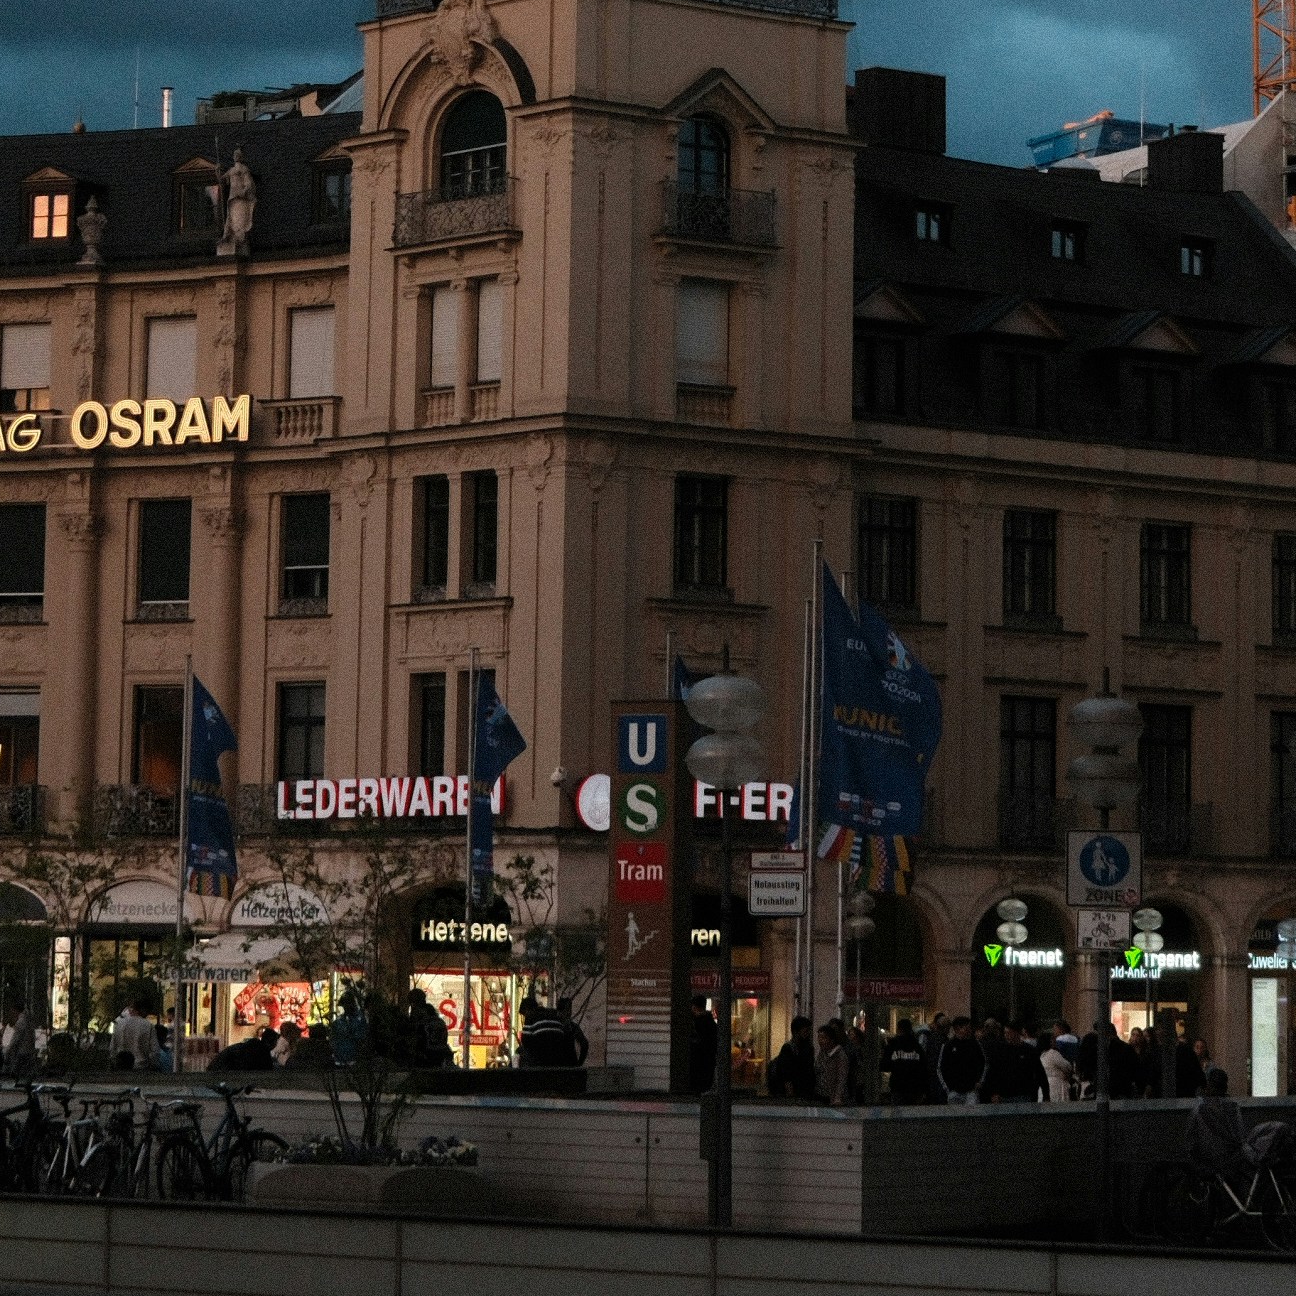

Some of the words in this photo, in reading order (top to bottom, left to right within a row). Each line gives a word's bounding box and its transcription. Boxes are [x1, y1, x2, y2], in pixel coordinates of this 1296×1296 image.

[70, 394, 251, 450] OSRAM
[628, 721, 657, 766] U
[624, 783, 659, 832] S
[617, 859, 664, 881] Tram
[1085, 888, 1123, 902] ZONE
[104, 902, 179, 917] etzenecke
[1004, 946, 1064, 968] freenet
